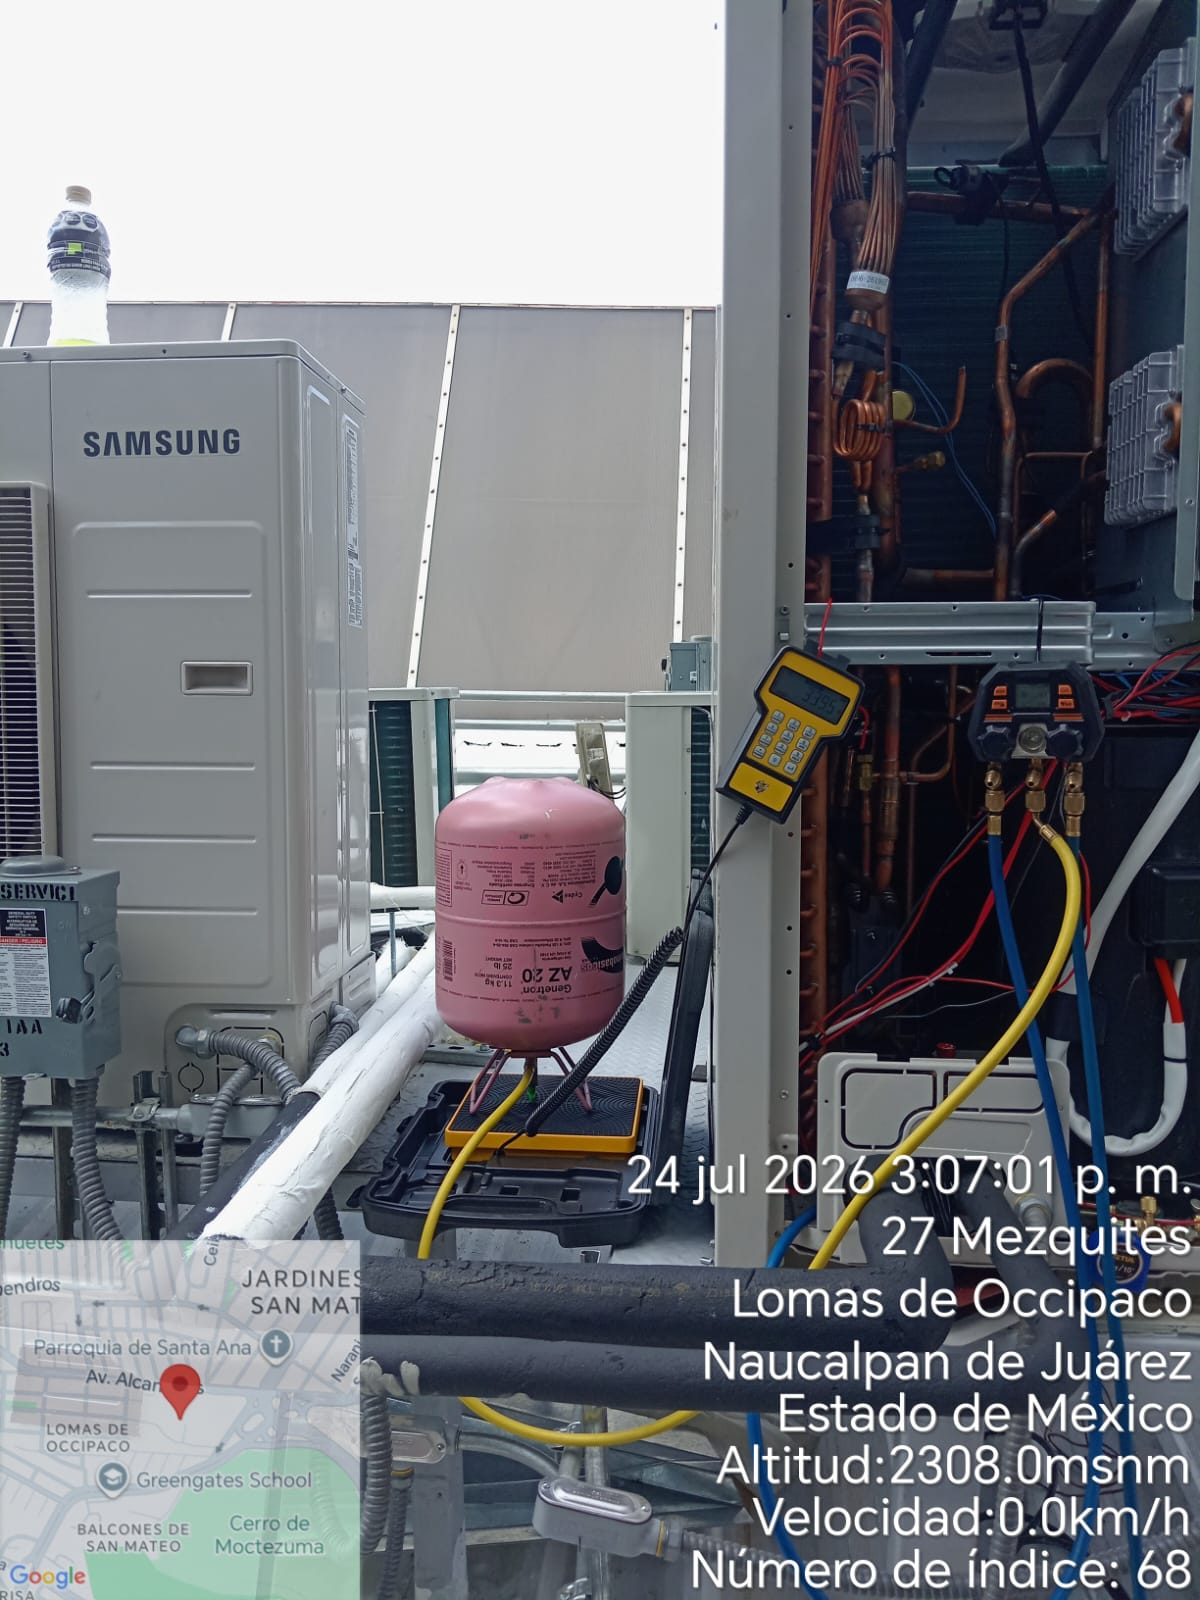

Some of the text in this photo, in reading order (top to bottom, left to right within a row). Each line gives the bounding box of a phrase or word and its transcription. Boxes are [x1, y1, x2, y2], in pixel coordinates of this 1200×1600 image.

[83, 428, 240, 457] SAMSUNG
[493, 961, 512, 970] 25 lb
[522, 966, 573, 983] AZ 20
[484, 978, 495, 987] kg
[522, 984, 572, 994] Genetron
